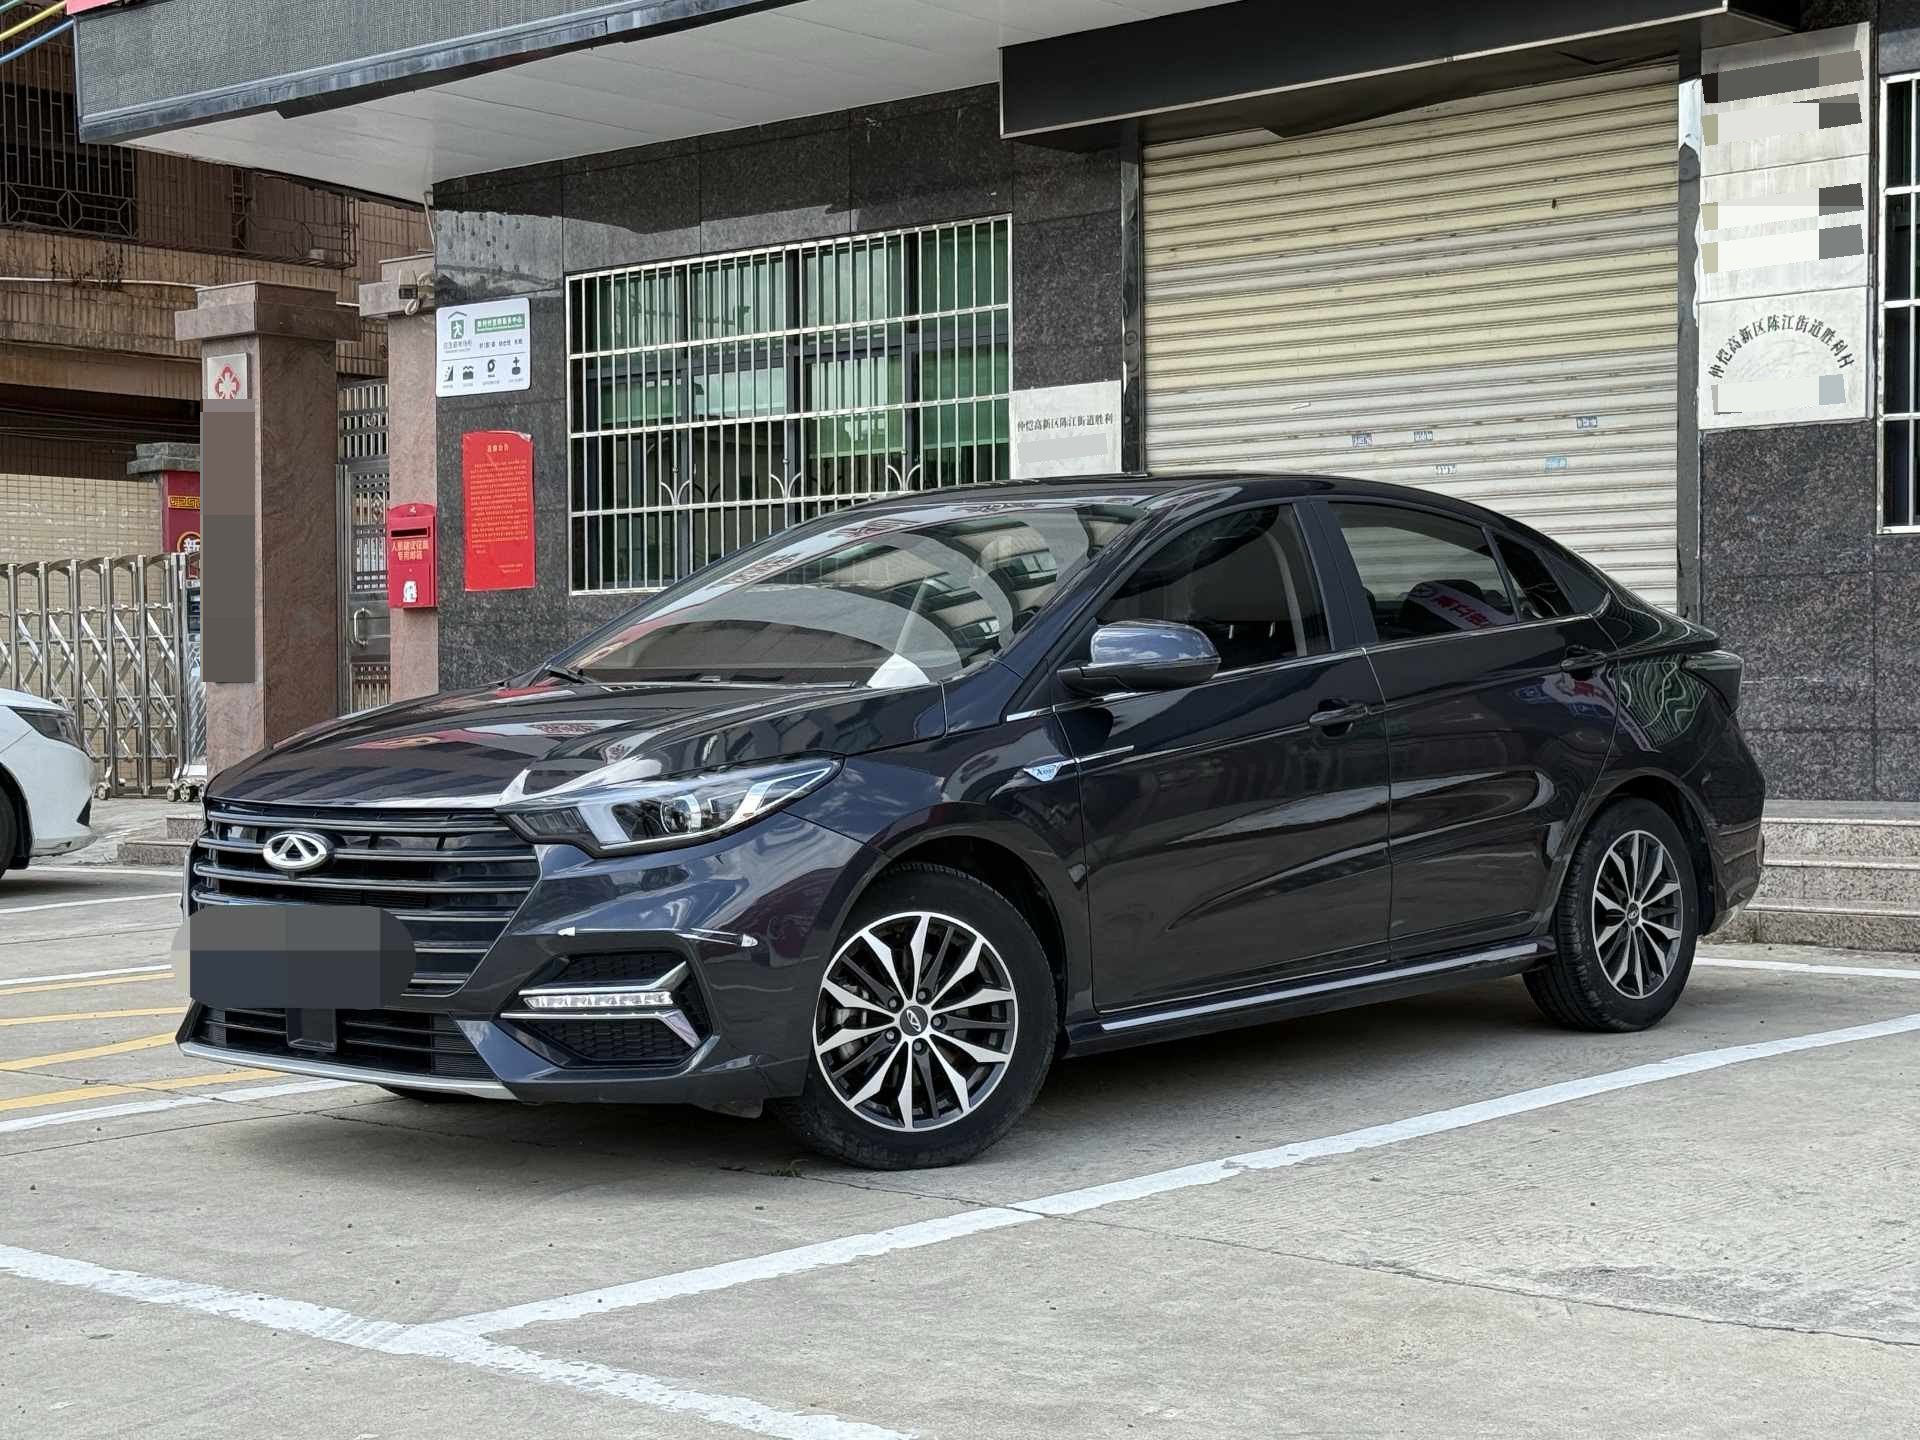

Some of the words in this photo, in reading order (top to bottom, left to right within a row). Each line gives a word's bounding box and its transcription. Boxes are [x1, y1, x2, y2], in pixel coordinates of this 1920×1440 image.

[1017, 412, 1113, 433] 仲恺高新区陈江街道胜利
